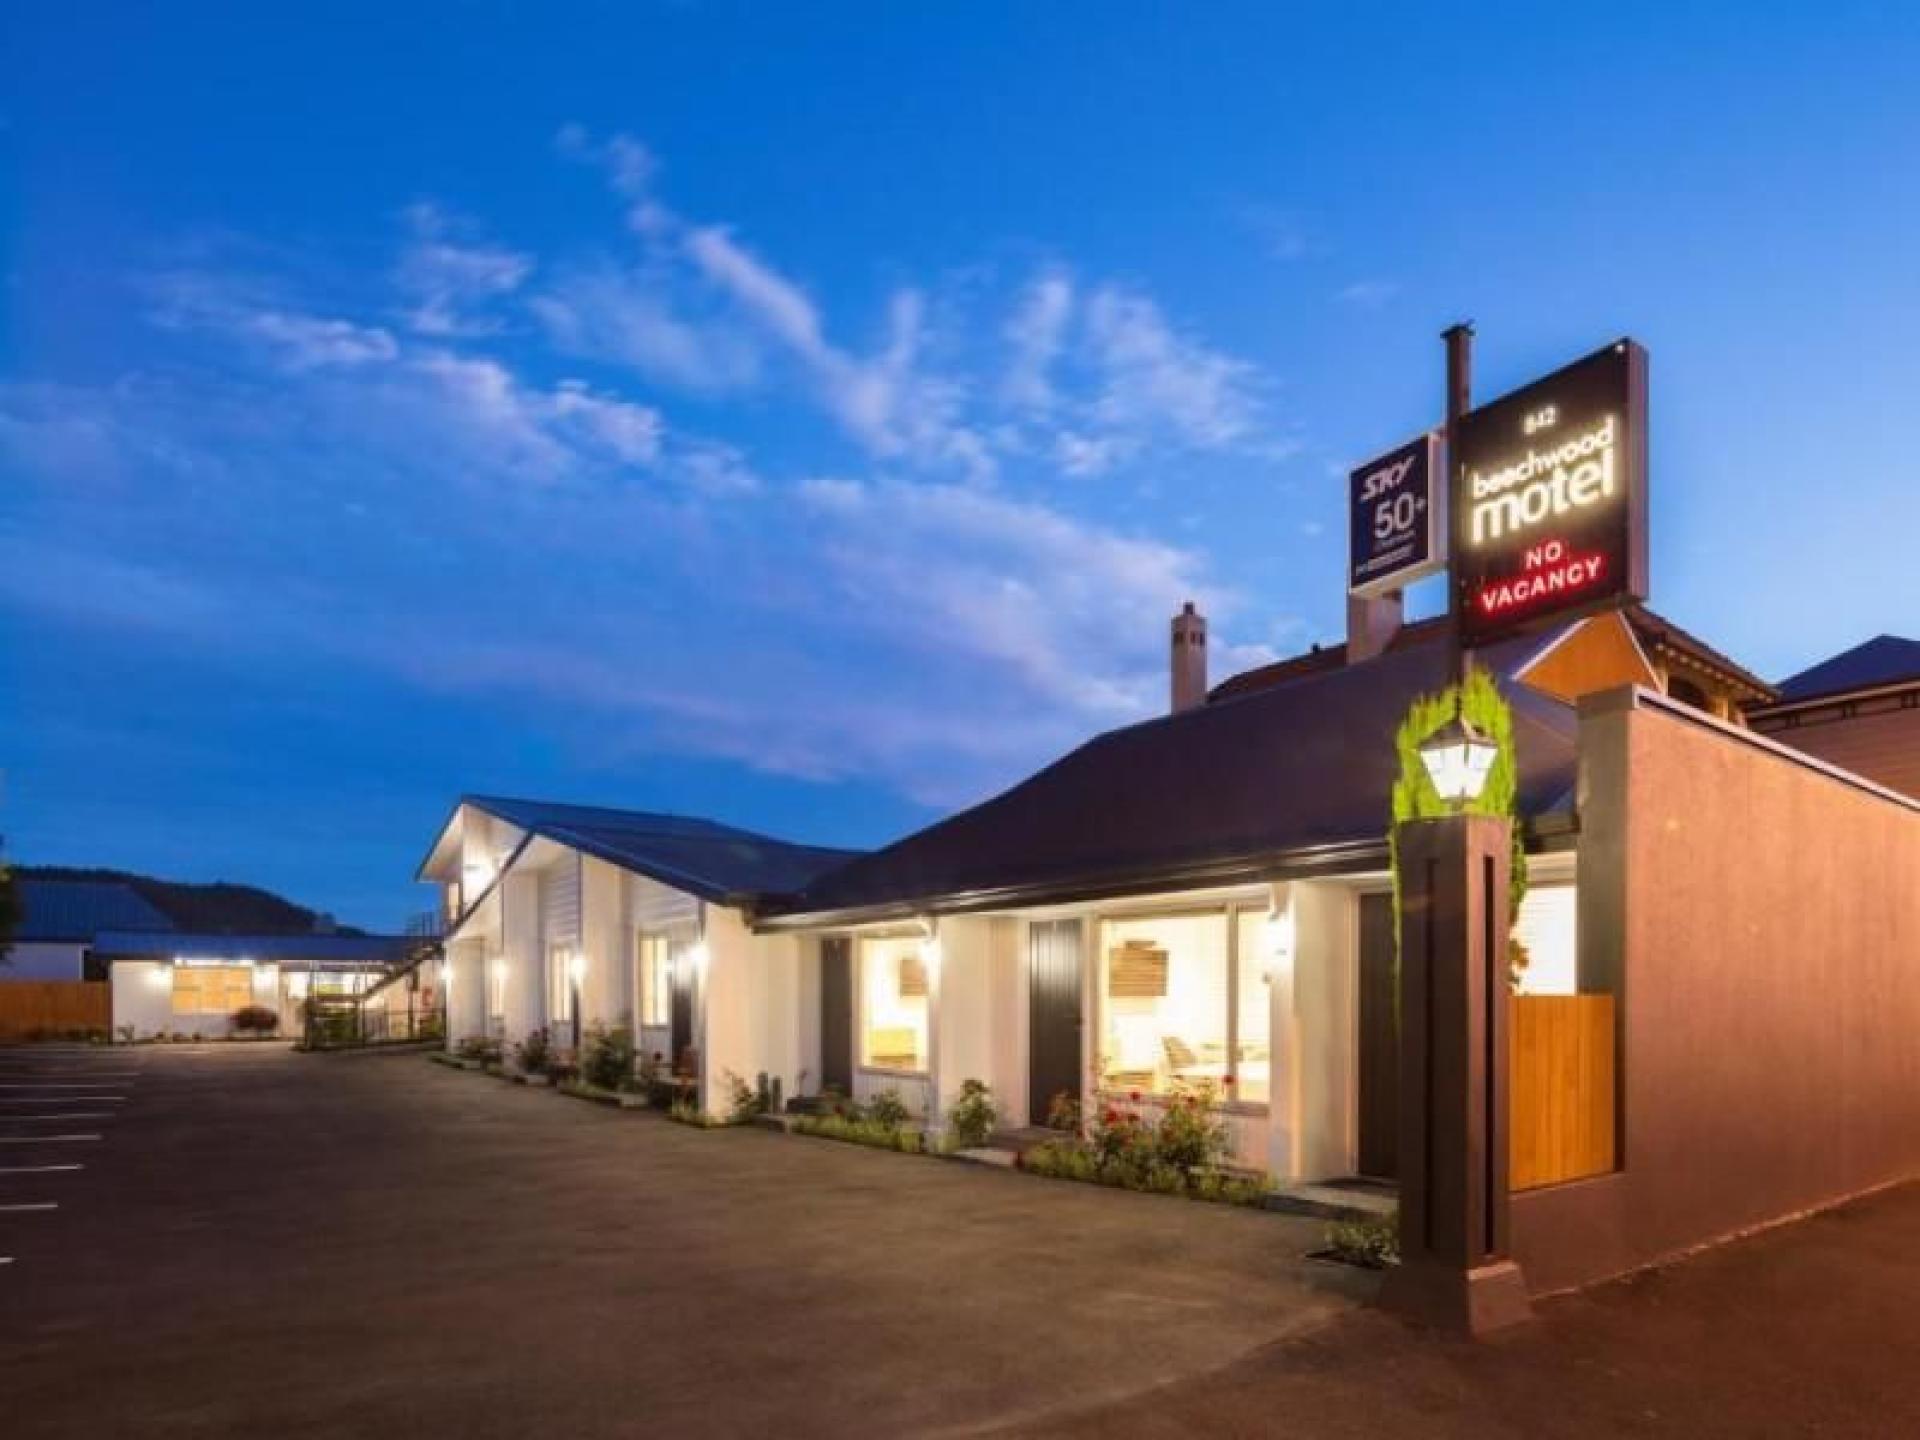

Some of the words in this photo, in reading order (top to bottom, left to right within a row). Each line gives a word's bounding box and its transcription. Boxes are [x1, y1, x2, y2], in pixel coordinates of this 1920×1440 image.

[1360, 456, 1416, 502] SKY
[1473, 415, 1615, 498] beechwood
[1473, 448, 1615, 545] motel
[1526, 540, 1562, 569] NO
[1482, 557, 1602, 611] VACANCY
